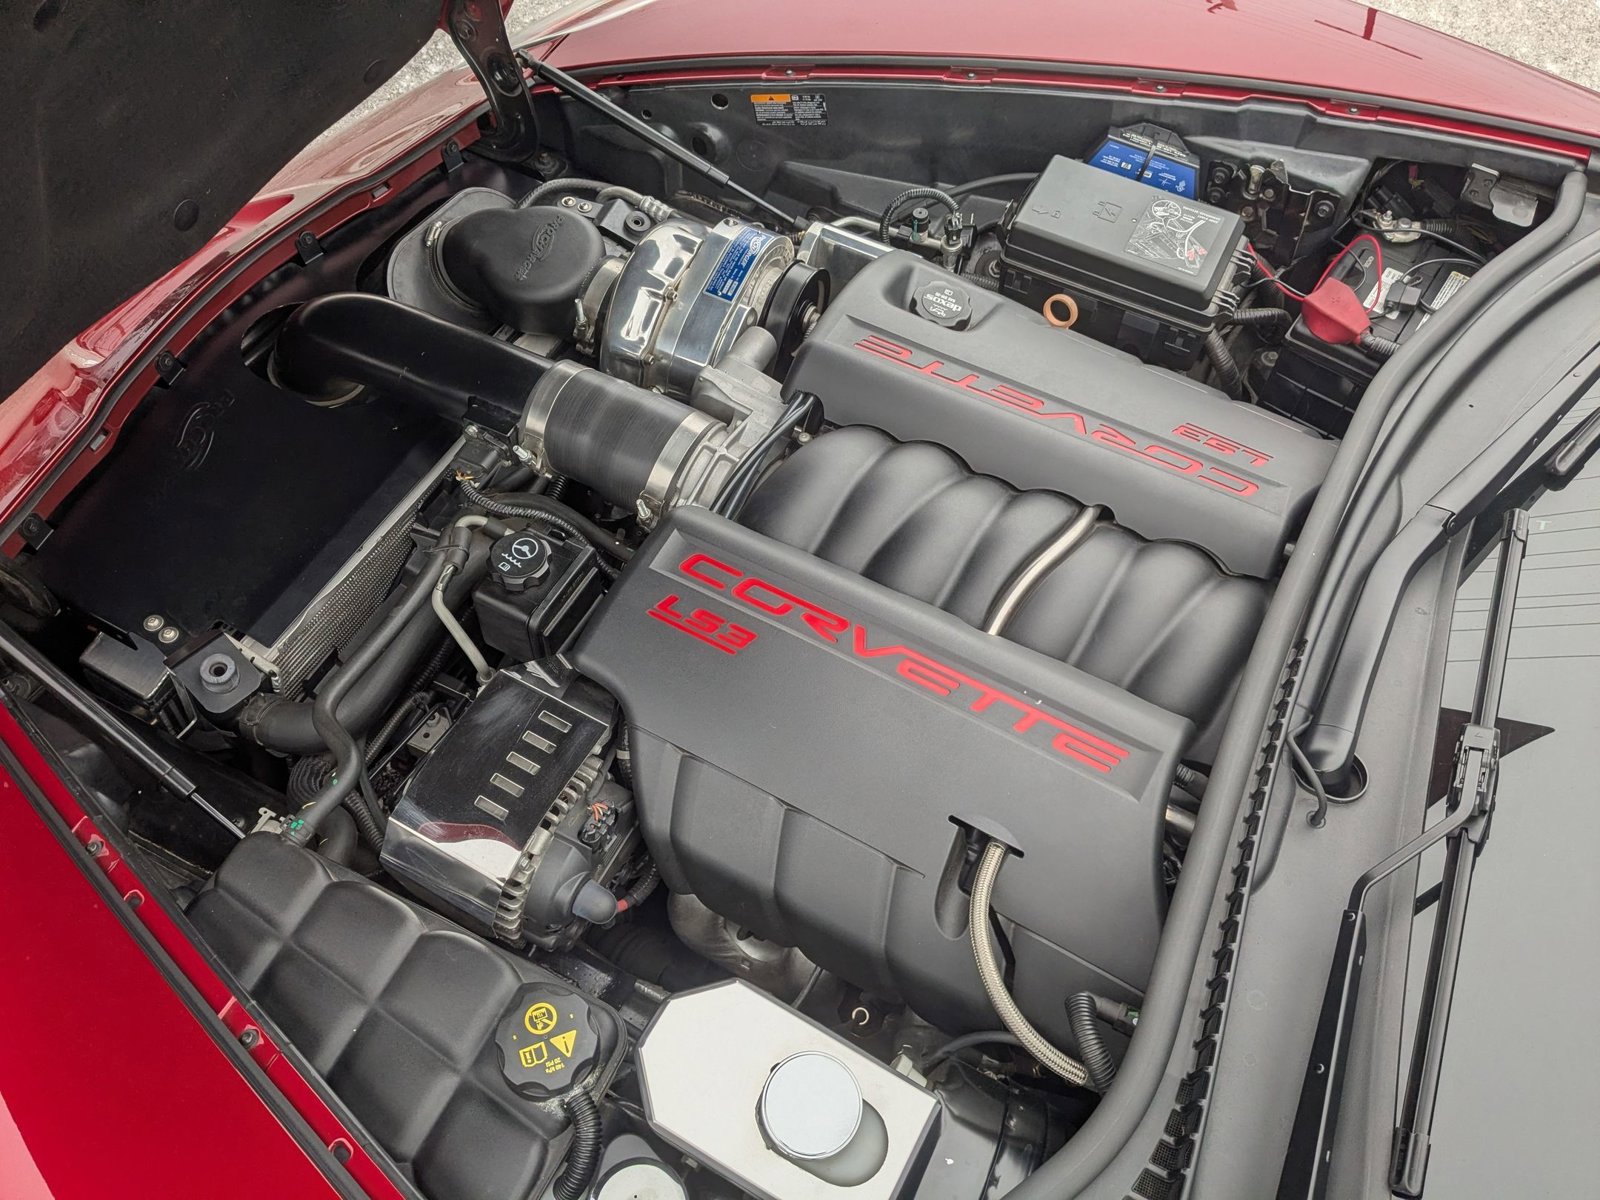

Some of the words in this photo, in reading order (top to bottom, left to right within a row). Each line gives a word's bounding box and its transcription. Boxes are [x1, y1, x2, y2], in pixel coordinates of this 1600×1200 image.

[924, 293, 962, 311] dexos
[853, 334, 1260, 497] CORVETTE
[1171, 423, 1274, 468] LS3
[646, 593, 758, 655] LS3
[678, 553, 1130, 774] CORVETTE
